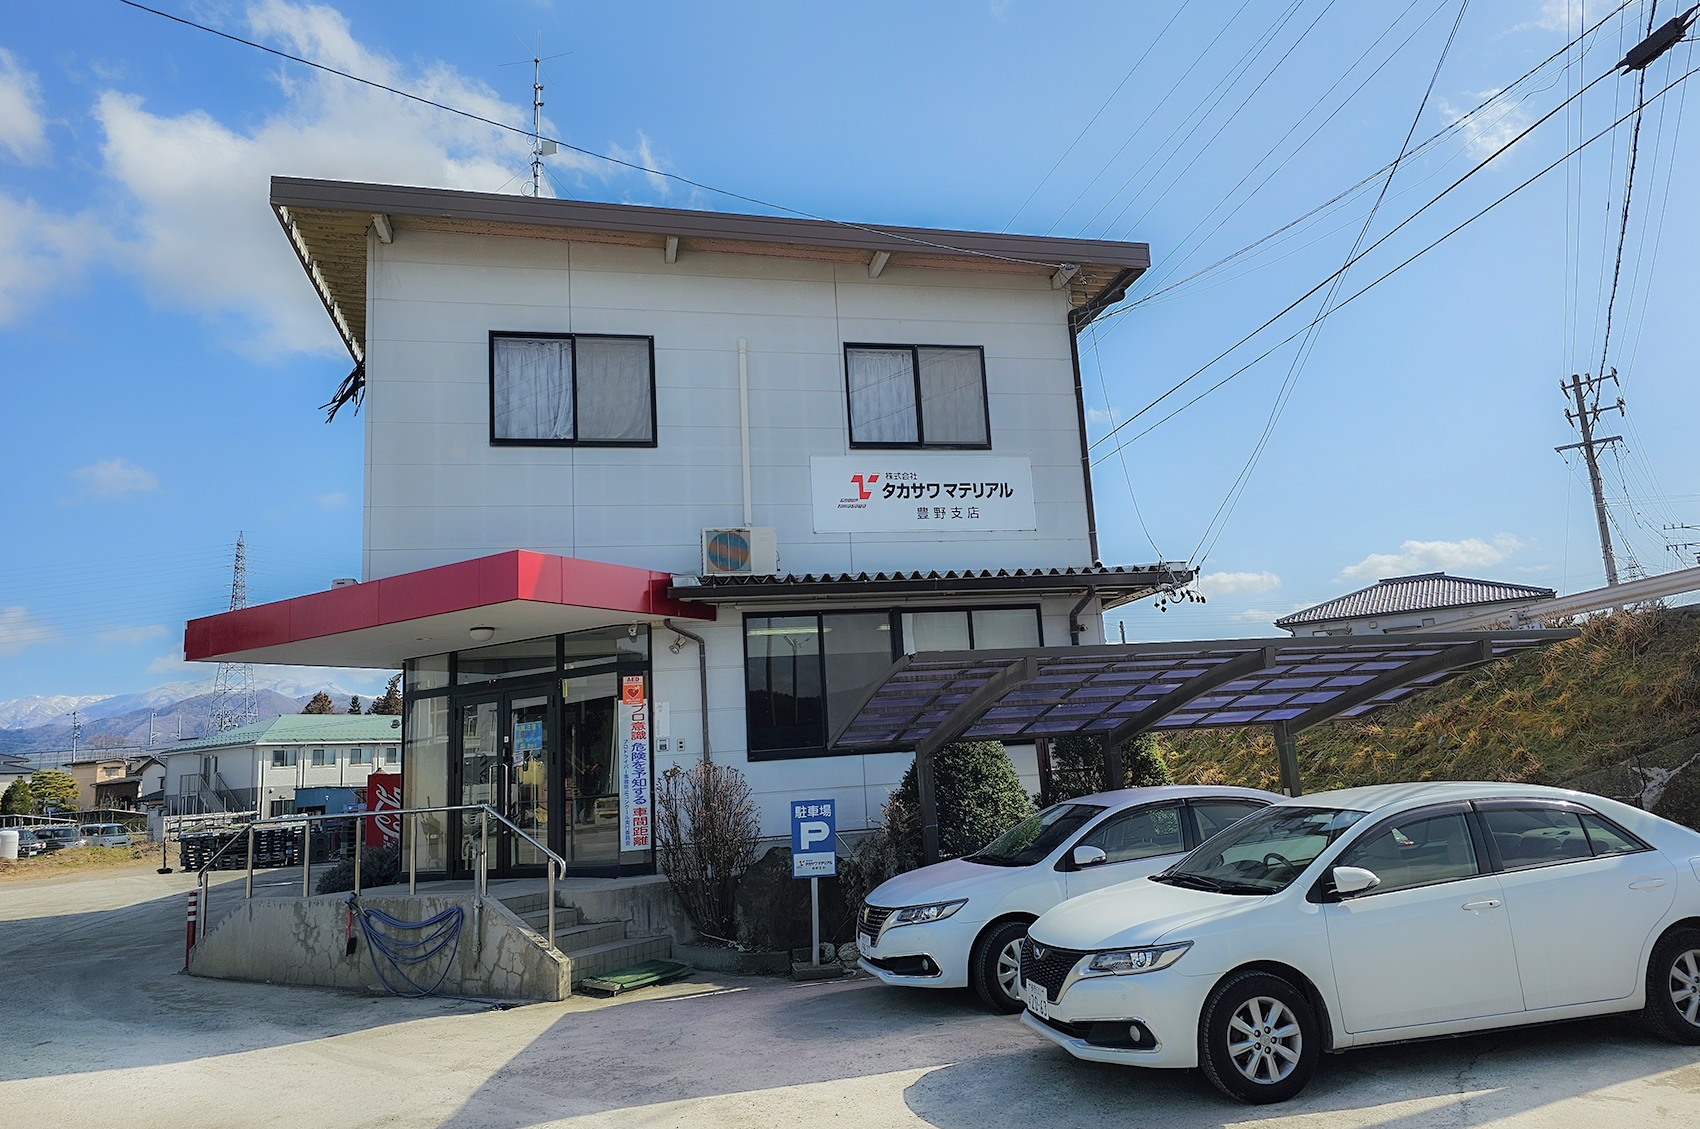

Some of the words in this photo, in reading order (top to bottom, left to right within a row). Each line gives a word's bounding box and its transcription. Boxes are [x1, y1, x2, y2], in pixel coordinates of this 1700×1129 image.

[885, 472, 918, 481] 株式会社
[917, 507, 980, 520] 豊野支店
[795, 804, 832, 818] 駐車場
[800, 821, 830, 850] P
